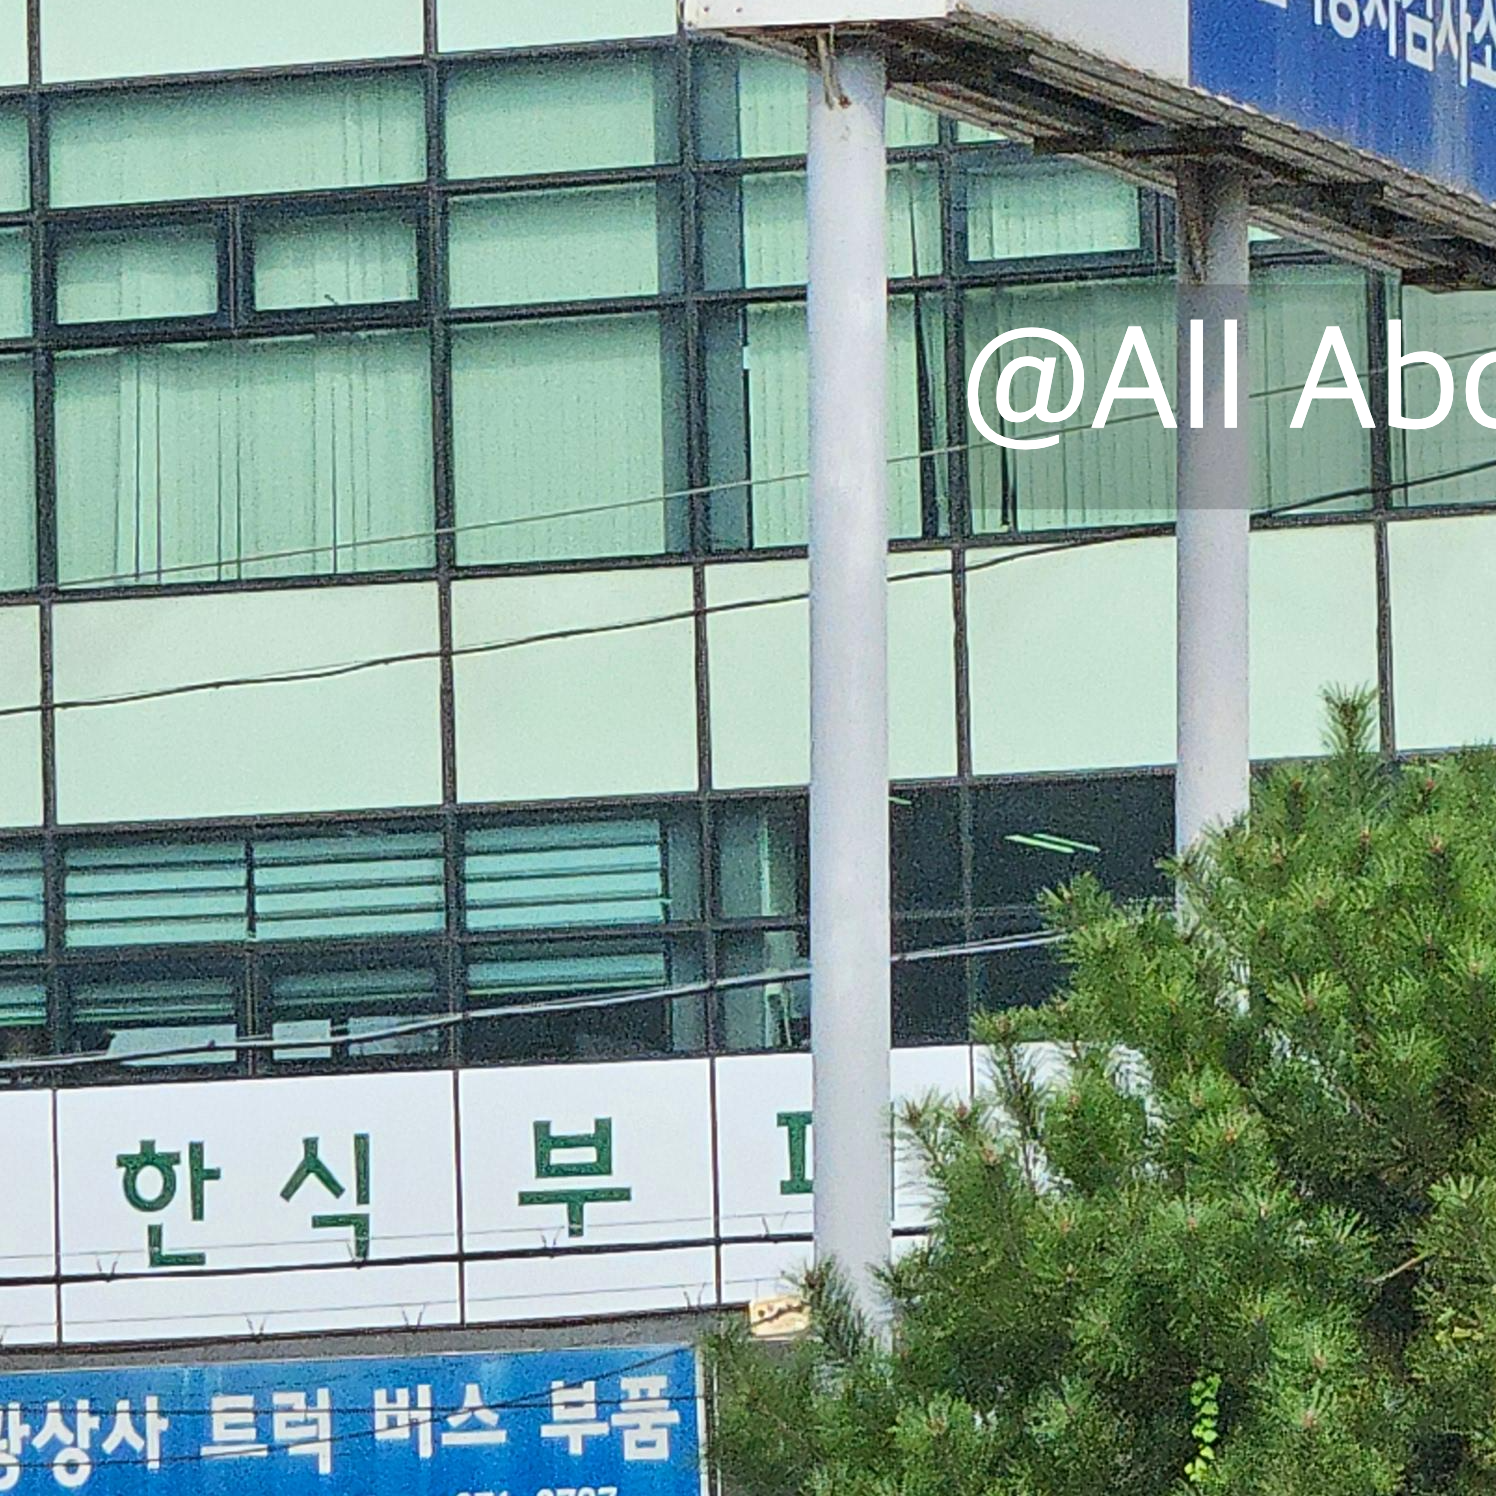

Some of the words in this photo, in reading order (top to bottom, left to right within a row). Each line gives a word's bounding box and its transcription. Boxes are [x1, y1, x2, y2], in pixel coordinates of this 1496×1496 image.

[201, 1388, 332, 1474] 트럭
[374, 1383, 507, 1458] 버스
[540, 1375, 680, 1461] 부품
